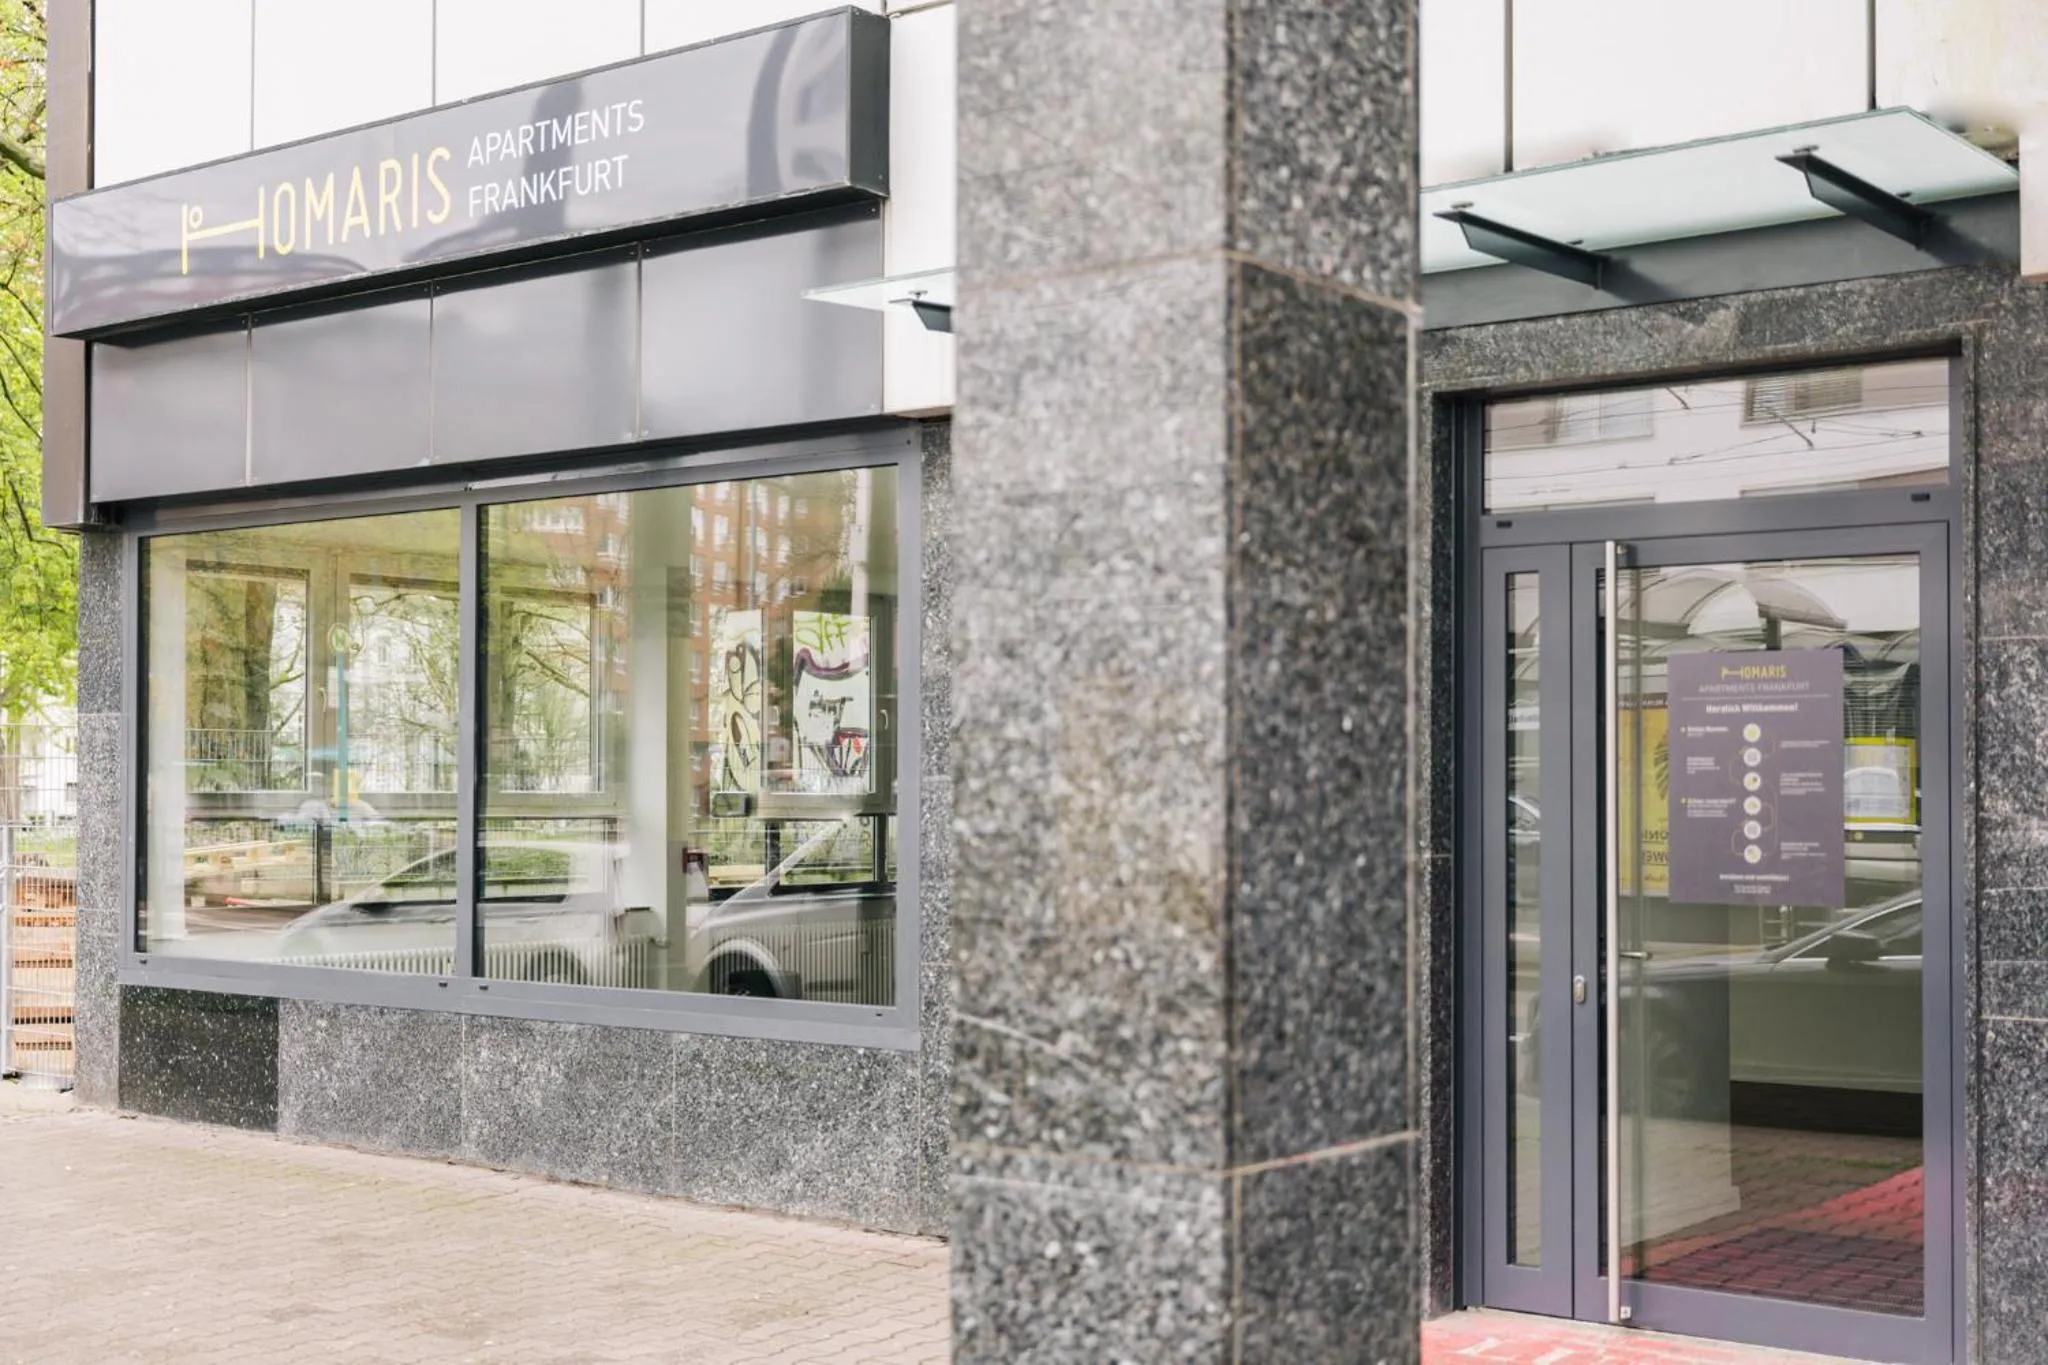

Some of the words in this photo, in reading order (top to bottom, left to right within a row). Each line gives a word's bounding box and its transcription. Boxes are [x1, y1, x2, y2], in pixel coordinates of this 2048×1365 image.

[467, 99, 646, 169] APARTMENTS
[180, 146, 452, 275] HOMARIS
[468, 154, 629, 219] FRANKFURT
[1698, 683, 1756, 694] APARTMENTS
[1758, 681, 1810, 692] FRANKFURT
[1721, 664, 1788, 681] HOMARIS
